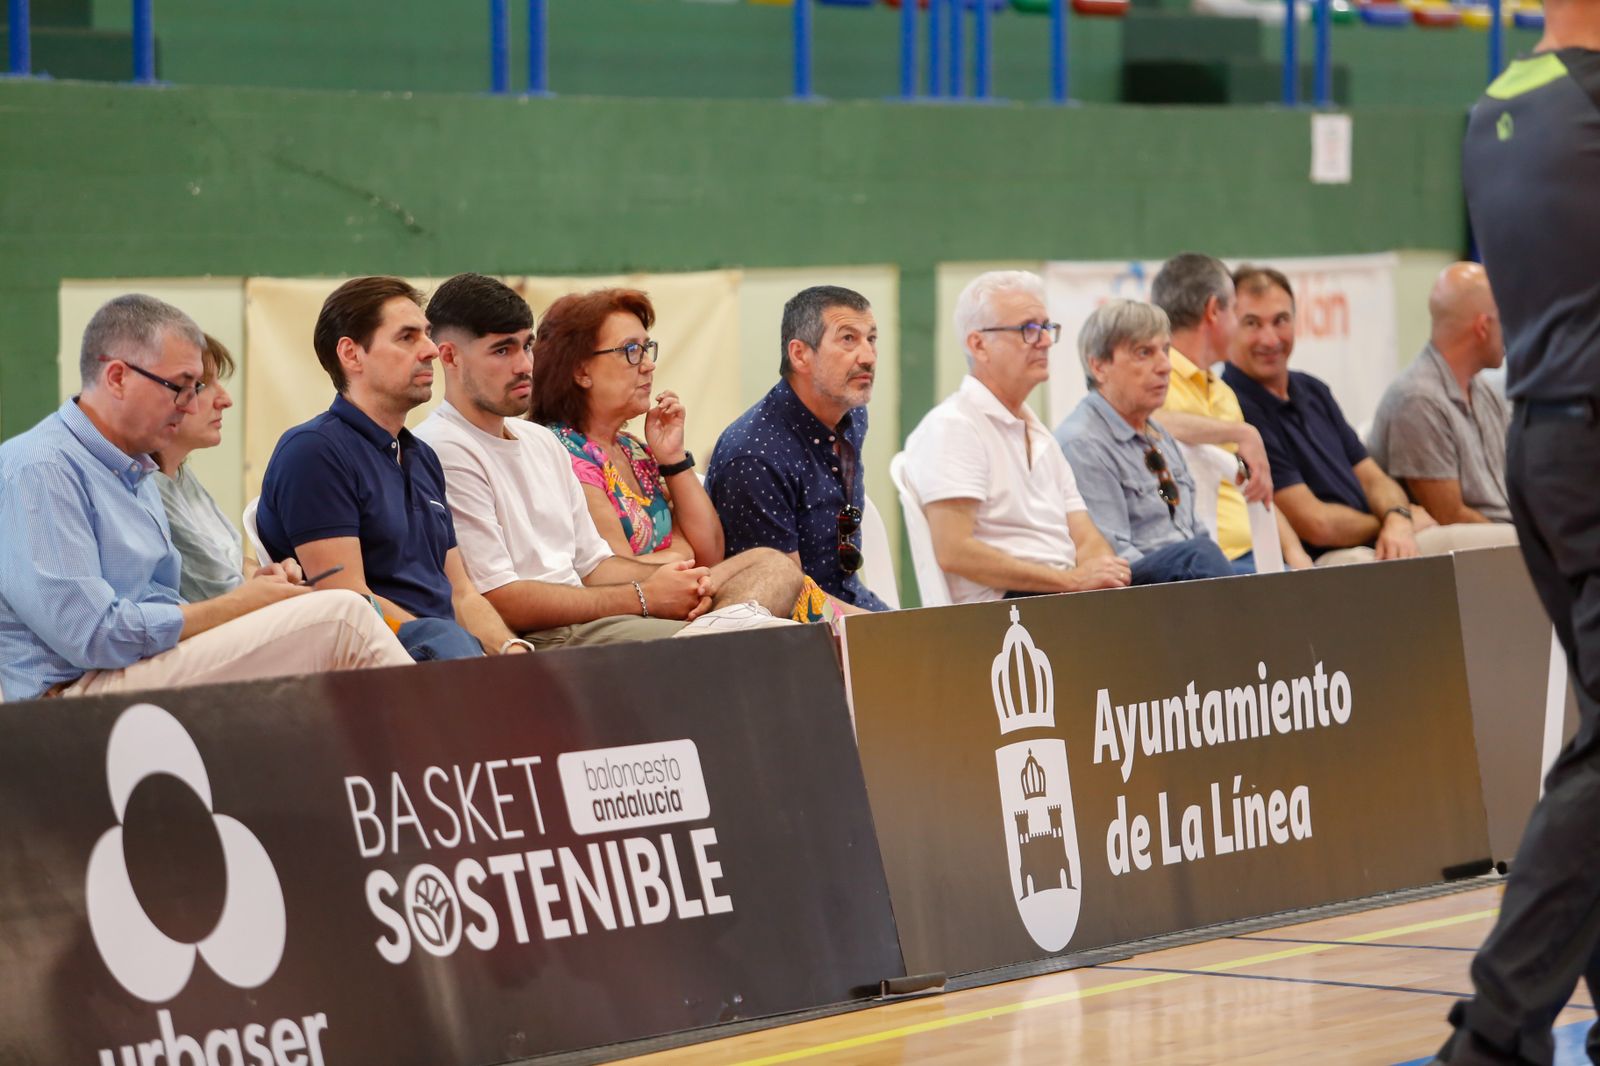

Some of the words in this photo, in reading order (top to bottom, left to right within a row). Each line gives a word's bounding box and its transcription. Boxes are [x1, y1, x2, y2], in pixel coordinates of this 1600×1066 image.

[583, 754, 681, 792] baloncesto
[1093, 661, 1353, 783] Ayuntamiento
[344, 755, 547, 858] BASKET
[592, 786, 683, 824] andalucia
[1106, 794, 1152, 876] de
[1159, 790, 1206, 866] La
[1210, 774, 1313, 857] Línea
[364, 827, 734, 965] SOSTENIBLE
